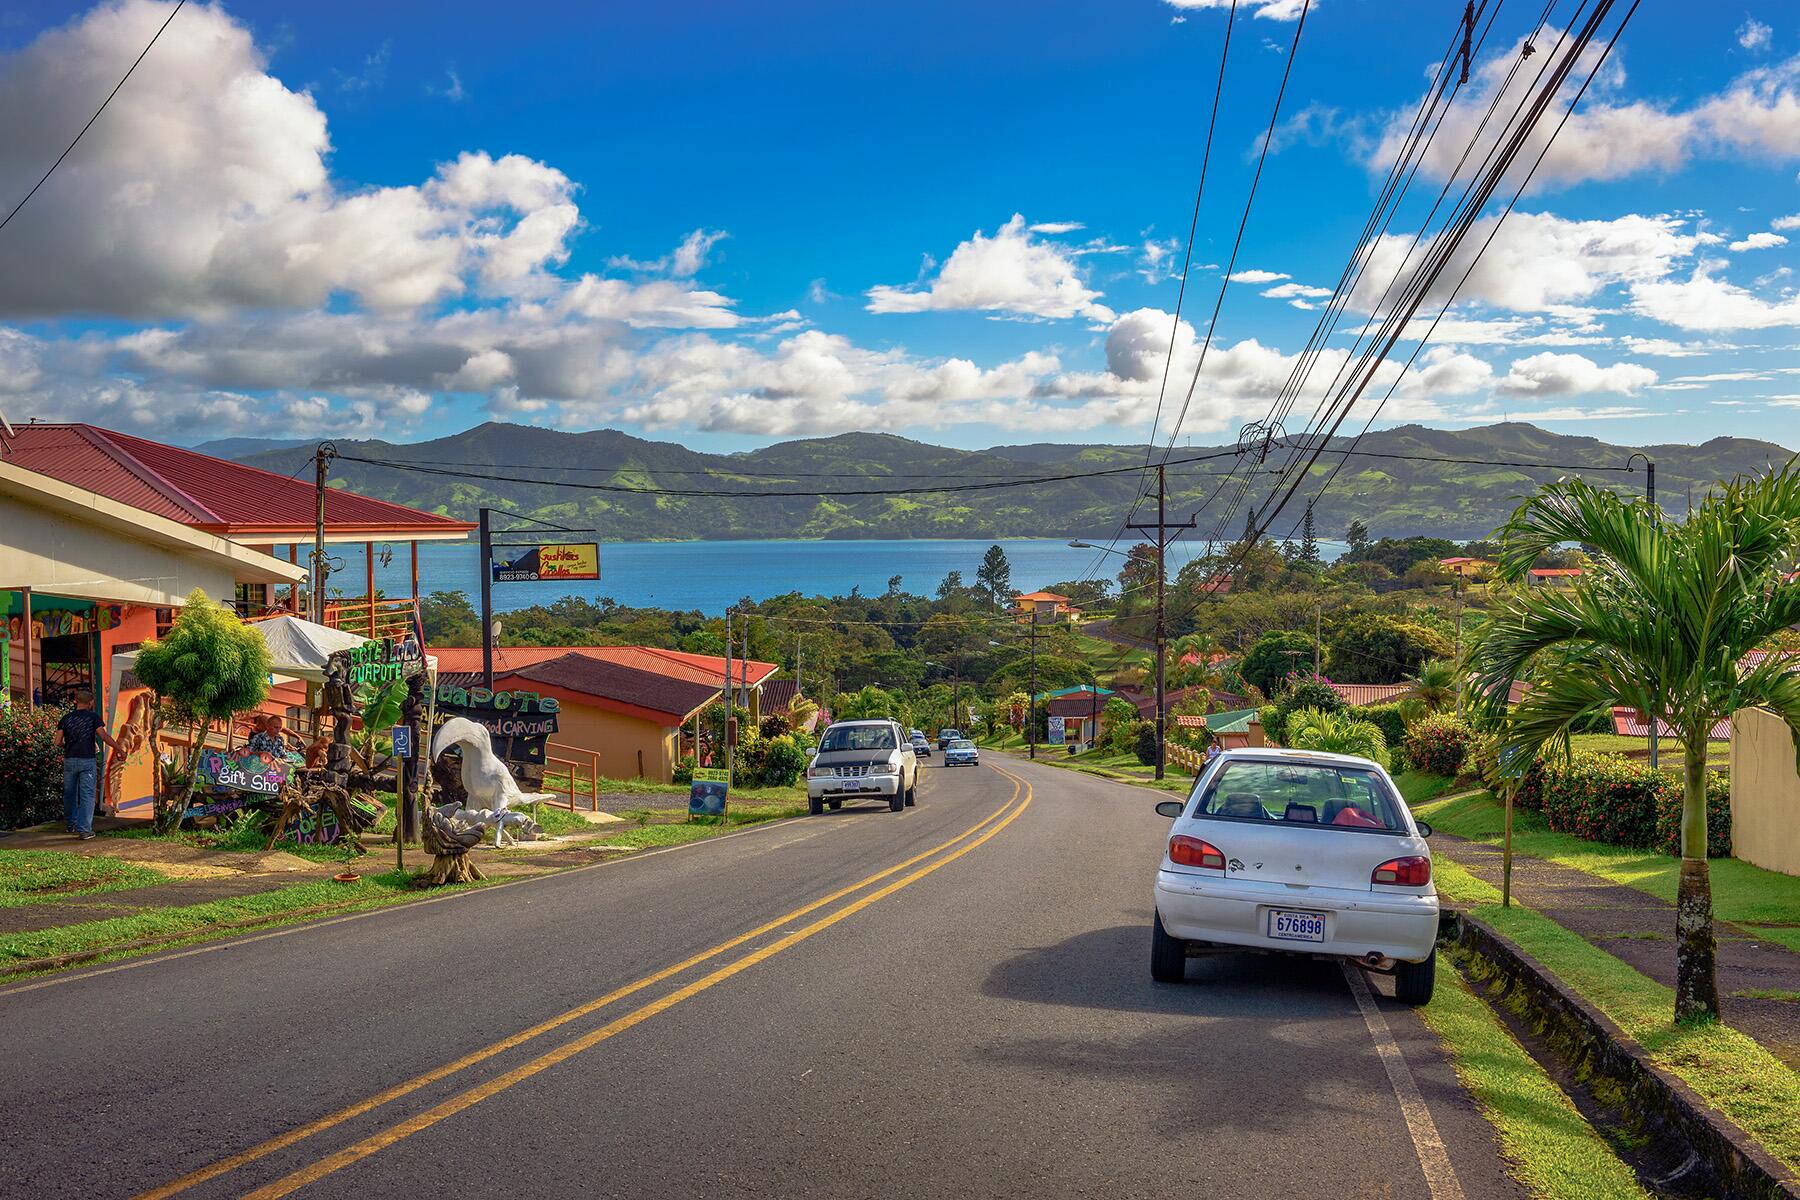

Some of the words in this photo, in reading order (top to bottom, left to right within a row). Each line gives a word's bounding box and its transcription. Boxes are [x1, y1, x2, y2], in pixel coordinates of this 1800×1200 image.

[349, 663, 402, 683] GUAPOTE
[502, 719, 554, 736] CARVING
[219, 764, 247, 786] gift
[1277, 917, 1322, 935] 676898
